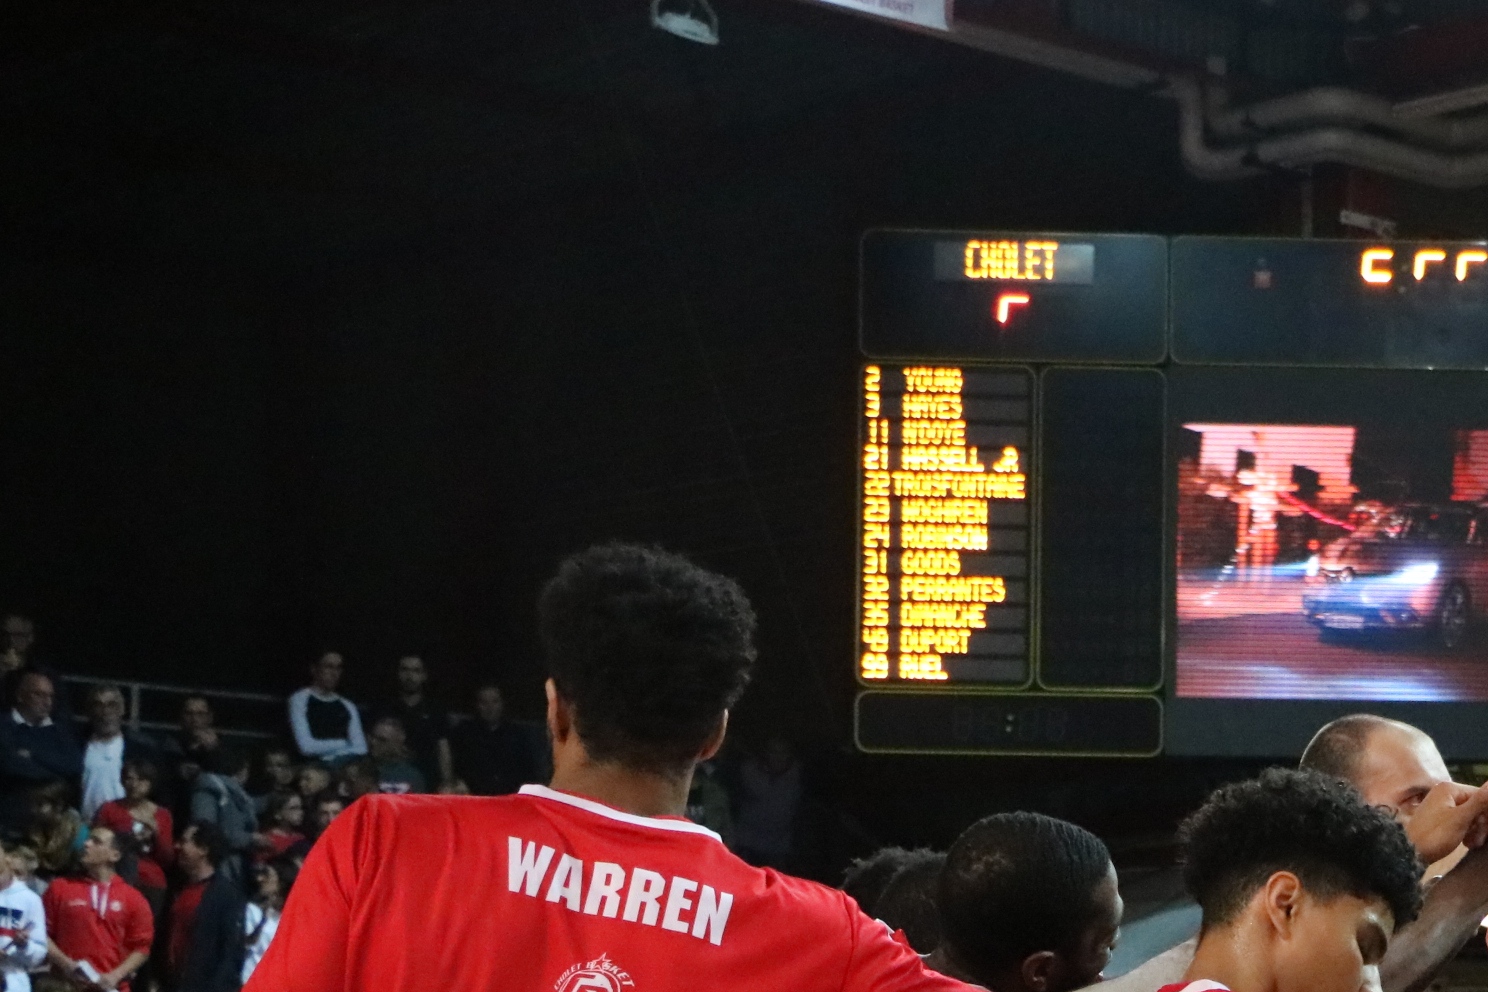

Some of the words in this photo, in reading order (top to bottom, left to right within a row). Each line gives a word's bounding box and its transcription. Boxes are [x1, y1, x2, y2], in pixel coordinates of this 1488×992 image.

[965, 240, 1058, 280] CHOLET
[864, 365, 881, 392] 2
[865, 392, 881, 418] 3
[868, 418, 889, 444] 11
[863, 444, 889, 470] 21
[863, 548, 888, 574] 31
[508, 836, 734, 947] WARREN
